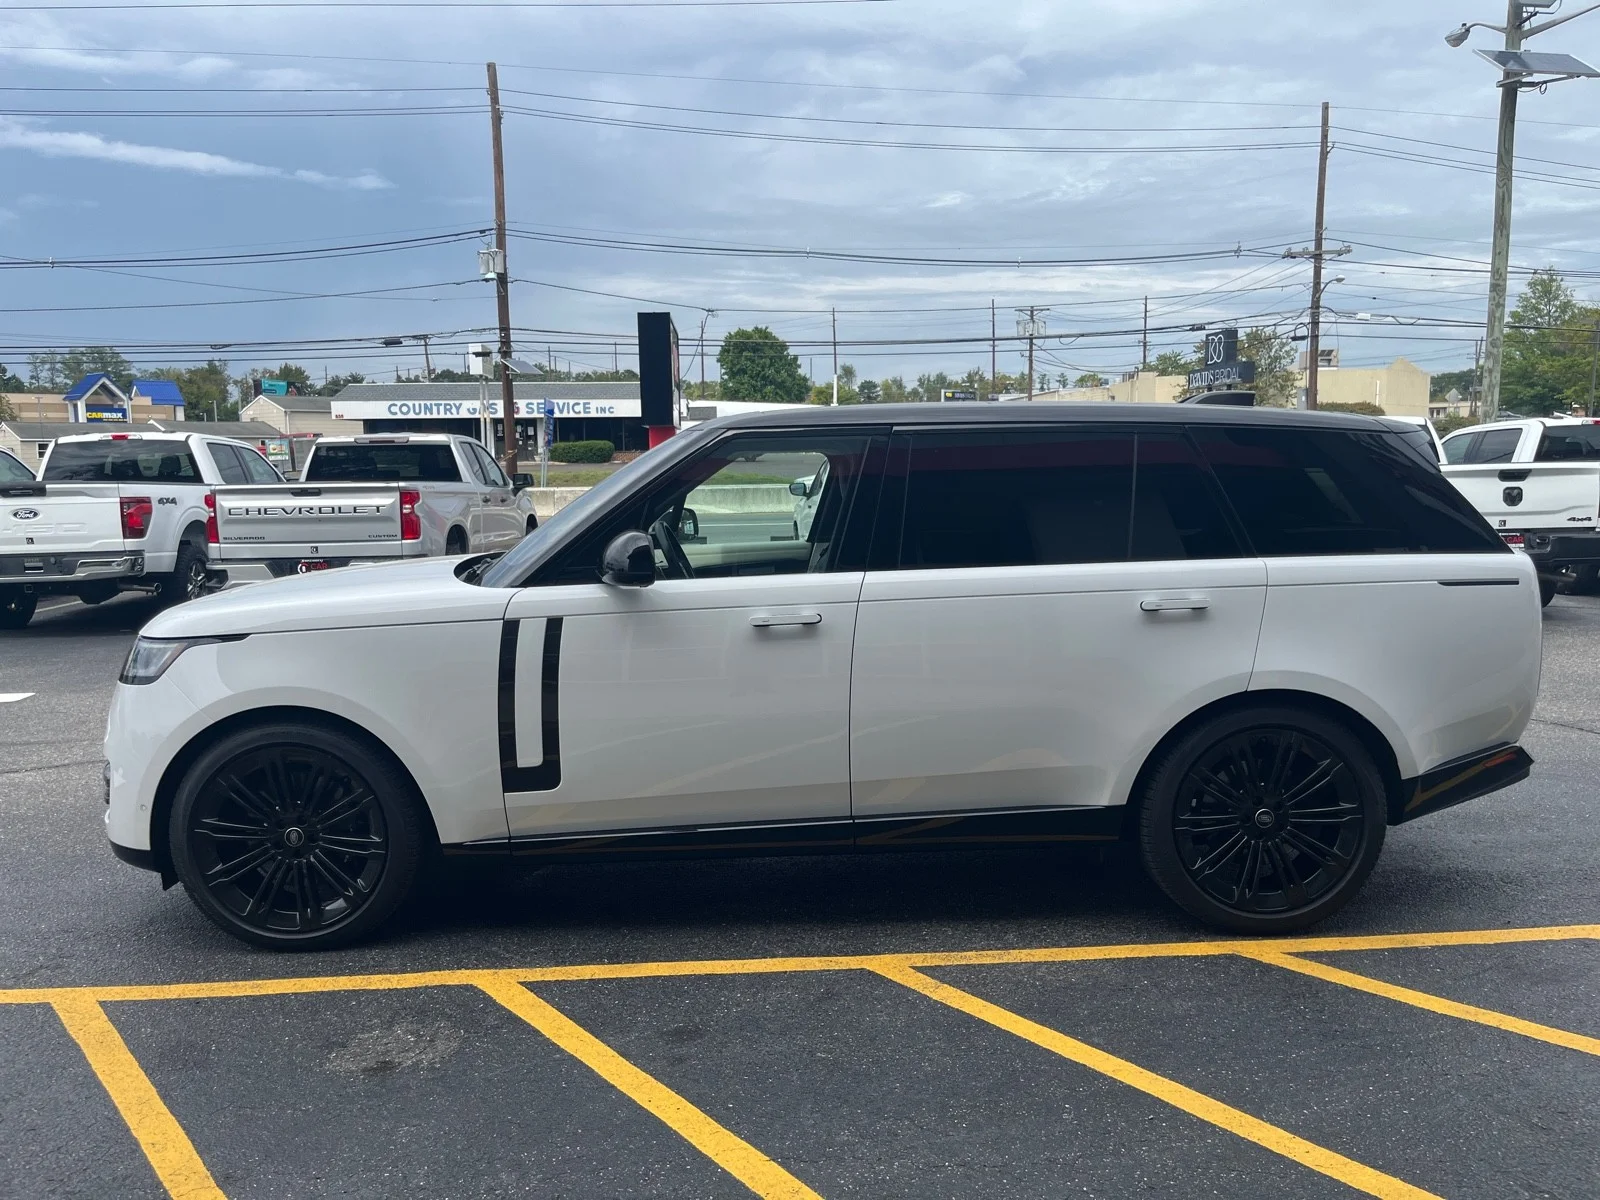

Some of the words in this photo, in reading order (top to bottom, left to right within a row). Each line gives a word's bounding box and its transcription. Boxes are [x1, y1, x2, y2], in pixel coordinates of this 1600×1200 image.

[387, 402, 462, 415] COUNTRY
[525, 402, 591, 415] SEVICE
[595, 406, 615, 414] INC
[15, 510, 36, 519] Ford
[228, 505, 387, 516] CHEVROLET
[1506, 536, 1524, 544] CAR
[310, 562, 328, 570] CAR
